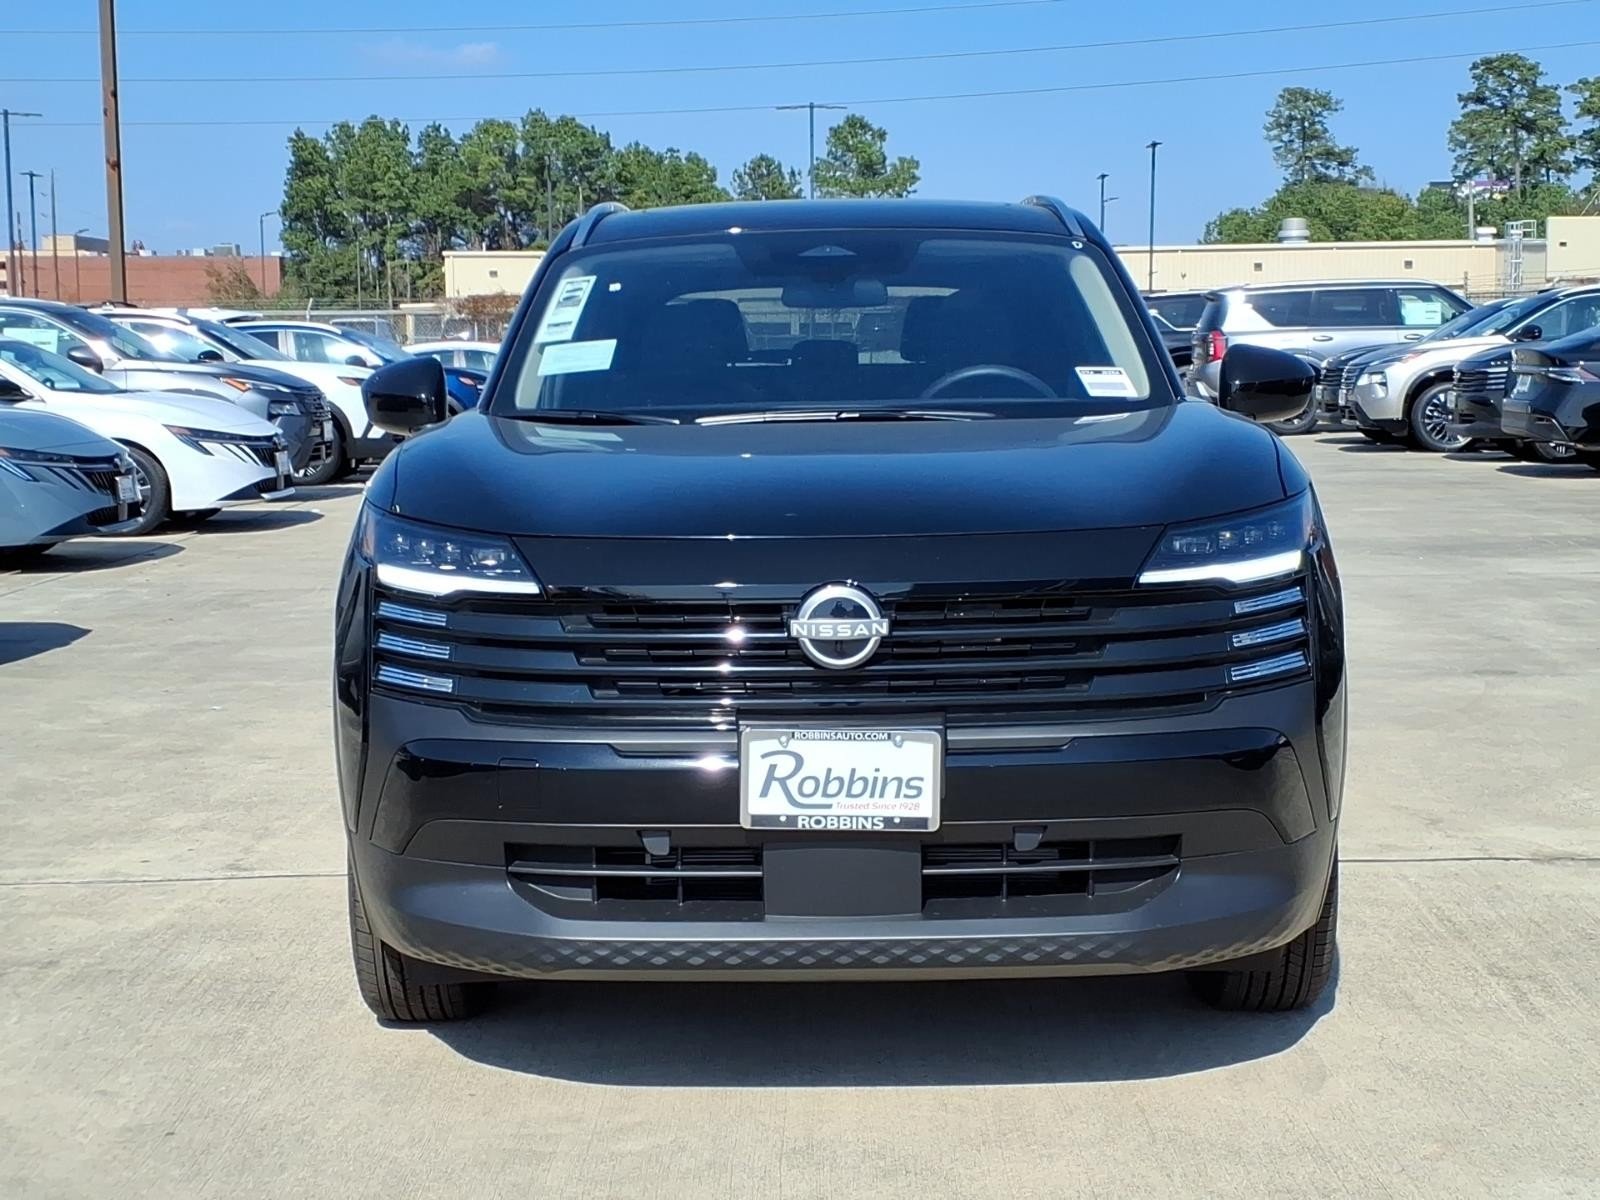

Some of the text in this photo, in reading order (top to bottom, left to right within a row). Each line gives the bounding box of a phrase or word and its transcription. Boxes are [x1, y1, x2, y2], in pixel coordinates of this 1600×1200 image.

[792, 622, 887, 637] NISSAN
[793, 731, 888, 741] ROBBINSAUTO.COM
[759, 750, 925, 809] Robbins
[836, 801, 920, 811] Trusted Since 1928
[797, 815, 885, 829] ROBBINS
